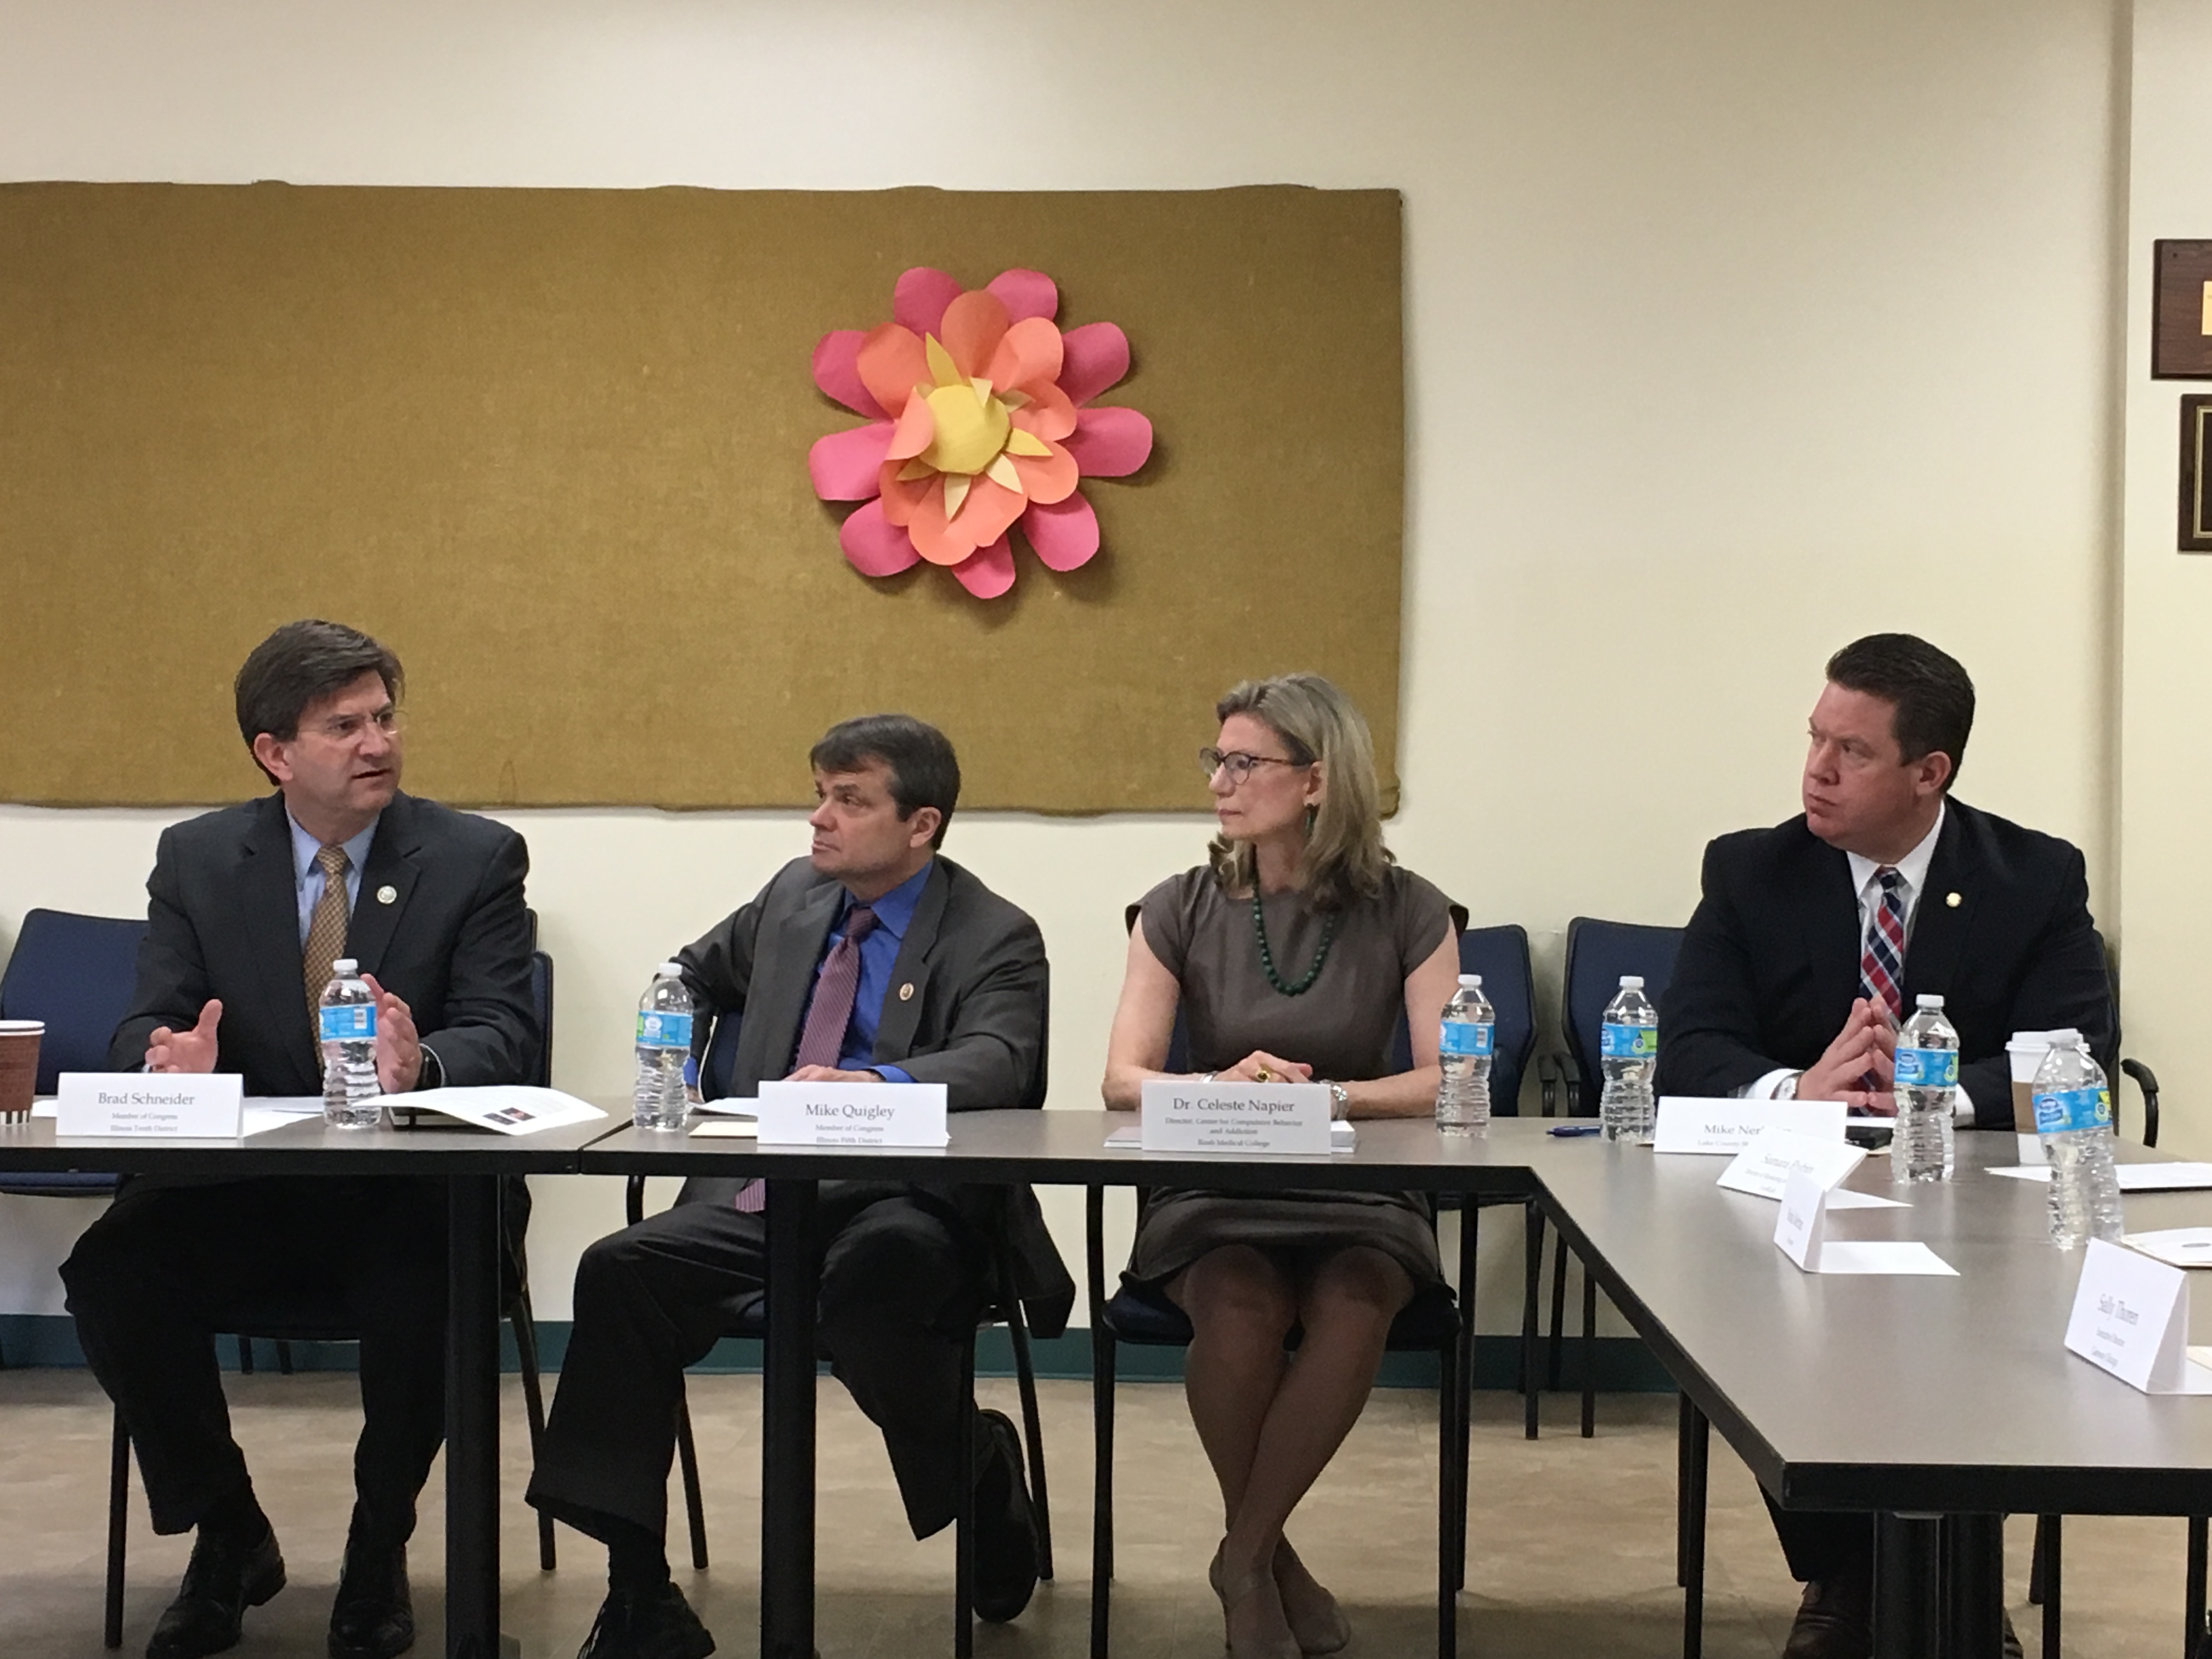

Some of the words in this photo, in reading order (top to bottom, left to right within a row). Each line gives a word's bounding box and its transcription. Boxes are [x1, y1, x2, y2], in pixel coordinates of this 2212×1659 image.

[98, 1092, 128, 1104] Brad
[131, 1092, 195, 1105] Schneider
[805, 1104, 839, 1116] Mike
[842, 1104, 895, 1120] Quigley
[1198, 1098, 1245, 1111] Celeste
[1249, 1099, 1295, 1114] Napier
[853, 1125, 884, 1133] Congress
[1704, 1124, 1735, 1135] Mike
[1244, 1139, 1270, 1148] College
